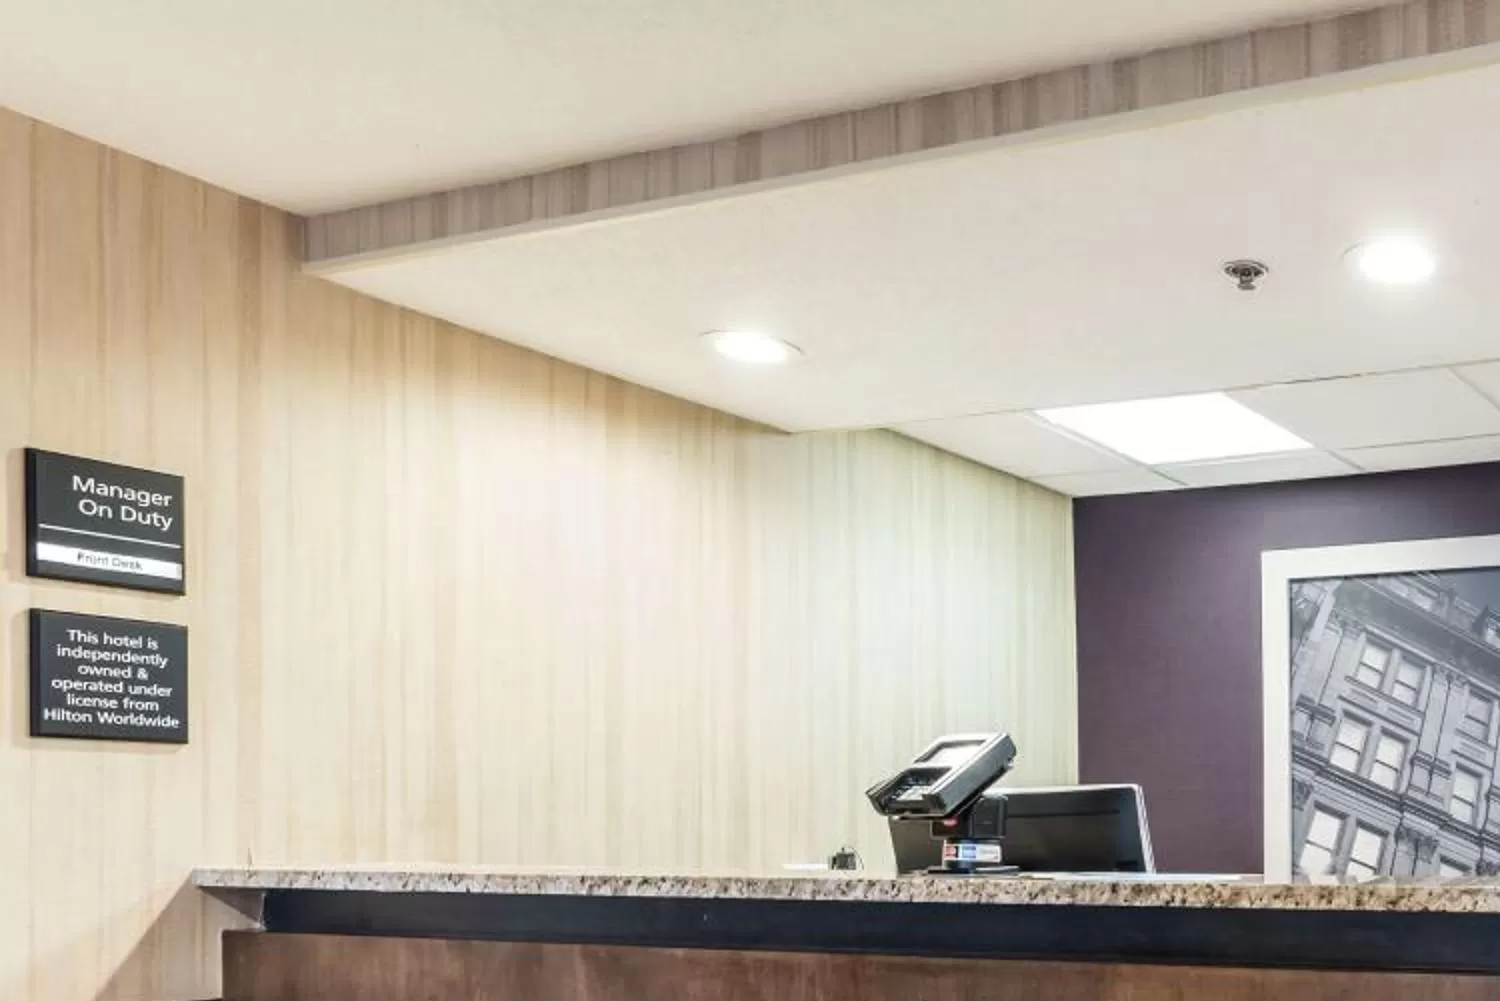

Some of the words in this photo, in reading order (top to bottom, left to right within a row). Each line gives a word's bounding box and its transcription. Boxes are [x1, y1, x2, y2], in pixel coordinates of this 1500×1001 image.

[71, 474, 173, 507] Manager
[78, 498, 113, 519] On
[120, 505, 173, 532] Duty
[77, 551, 110, 566] Front
[111, 556, 144, 571] Desk
[66, 629, 99, 644] This
[103, 632, 143, 649] hotel
[147, 636, 159, 650] is
[56, 643, 169, 669] independently
[77, 664, 132, 680] owned
[137, 667, 149, 681] &
[51, 678, 124, 694] operated
[128, 684, 173, 698] under
[66, 693, 119, 709] license
[123, 697, 159, 712] from
[43, 707, 93, 724] Hilton
[97, 711, 180, 728] Worldwide
